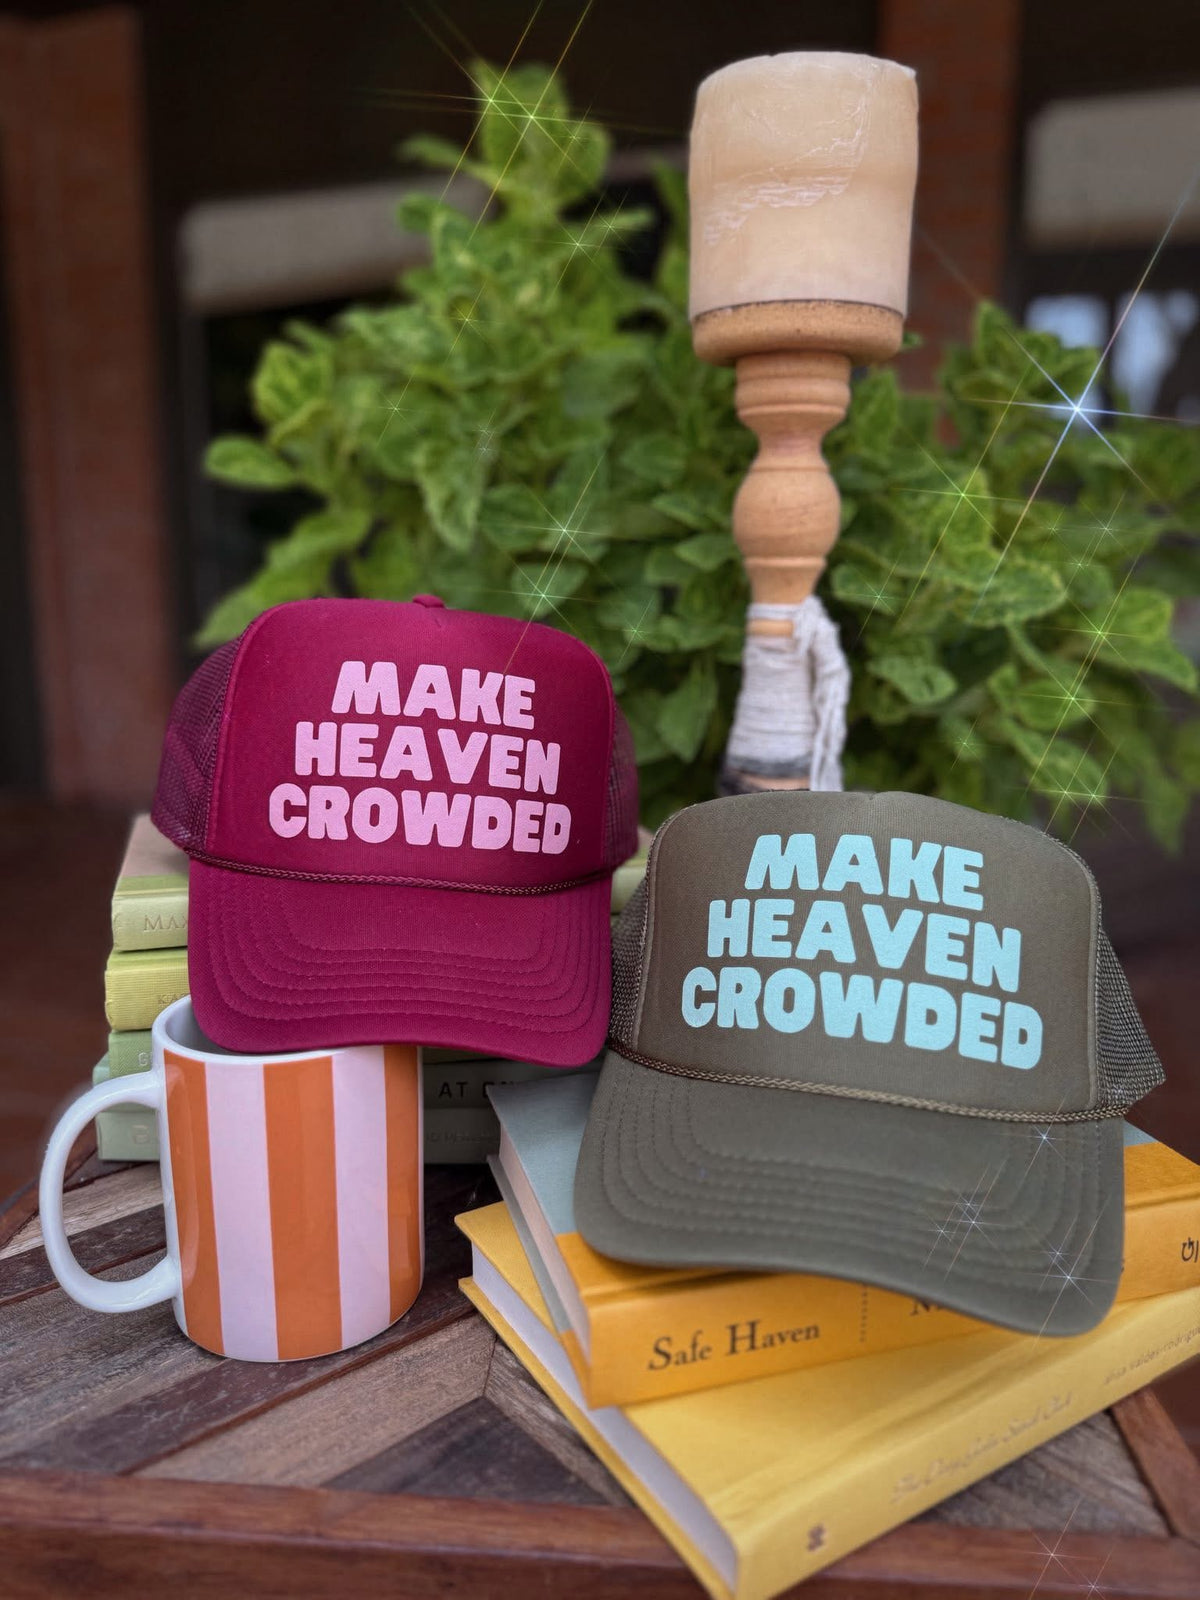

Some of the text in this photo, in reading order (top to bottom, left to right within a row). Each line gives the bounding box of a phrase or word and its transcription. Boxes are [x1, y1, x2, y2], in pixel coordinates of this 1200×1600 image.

[331, 661, 535, 730] MAKE
[295, 721, 561, 795] HEAVEN
[269, 783, 572, 854] CROWDED
[744, 833, 984, 911] MAKE
[707, 898, 1022, 993] HEAVEN
[681, 966, 1044, 1070] CROWDED
[438, 1081, 469, 1098] AT
[648, 1318, 821, 1371] Safe Haven
